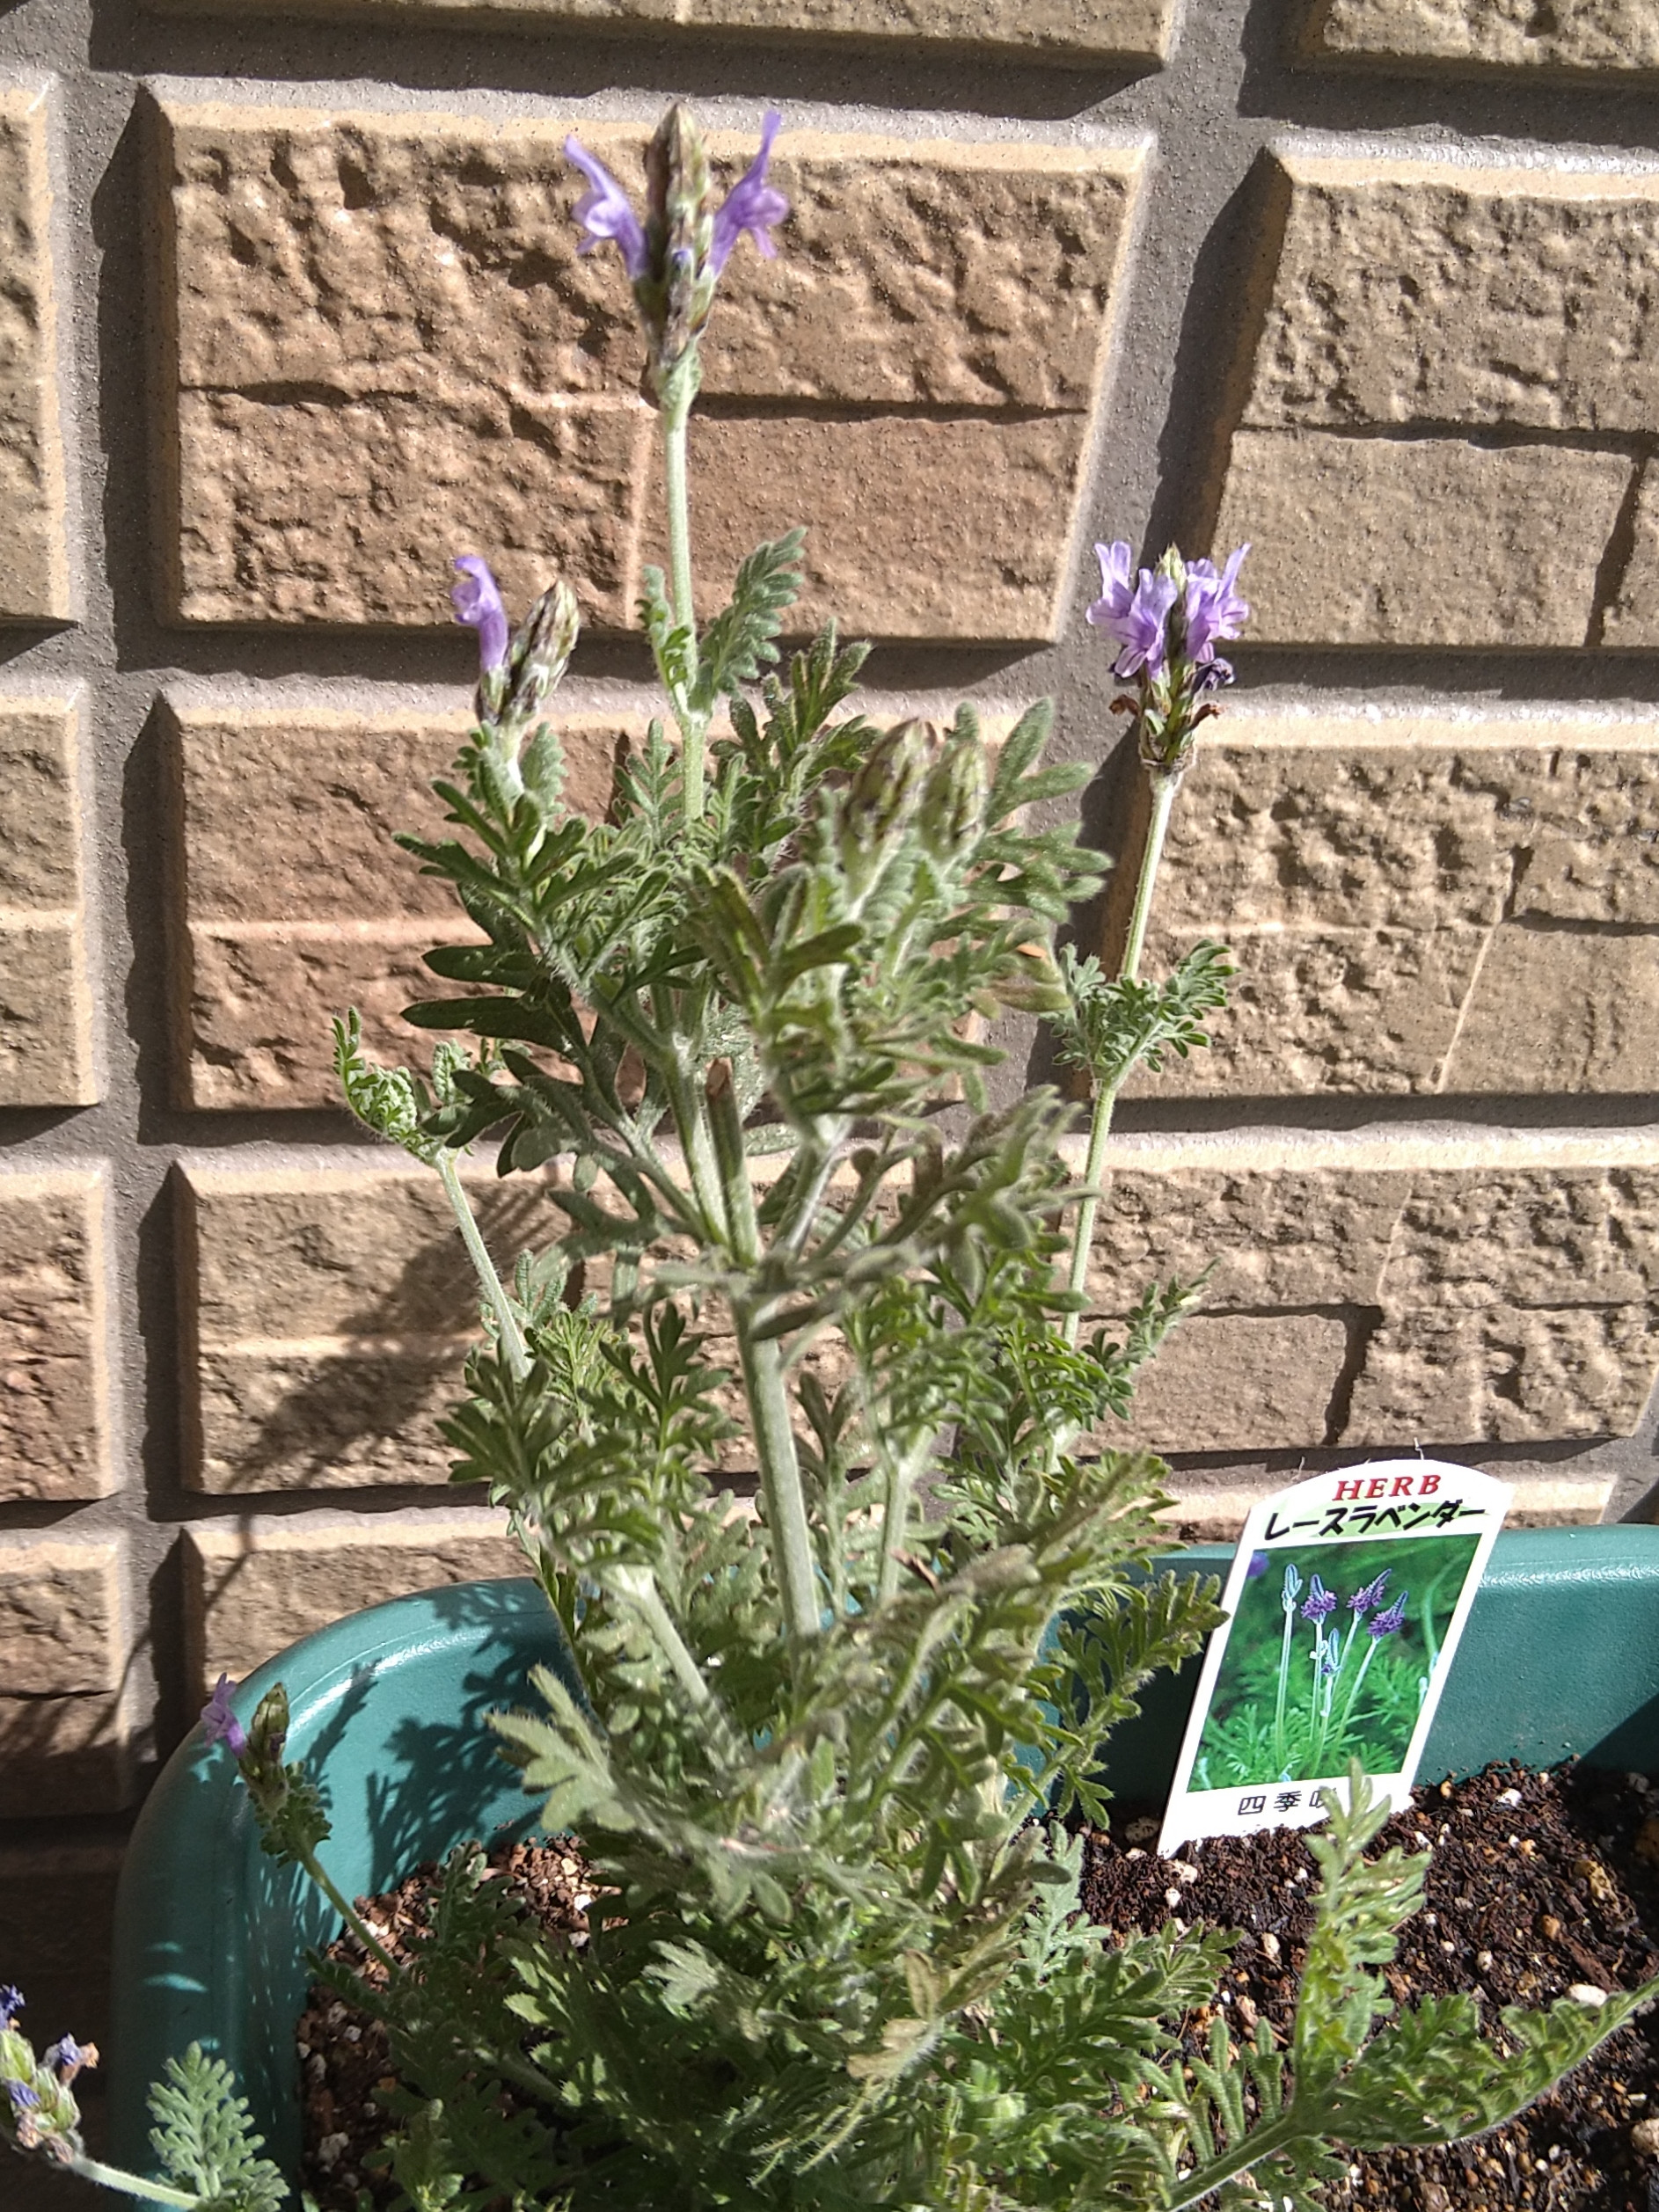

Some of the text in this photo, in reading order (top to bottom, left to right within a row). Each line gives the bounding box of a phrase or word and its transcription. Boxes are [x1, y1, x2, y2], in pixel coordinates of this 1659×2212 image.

[1332, 1474, 1442, 1501] HERB
[1264, 1498, 1487, 1541] レースラベンダー
